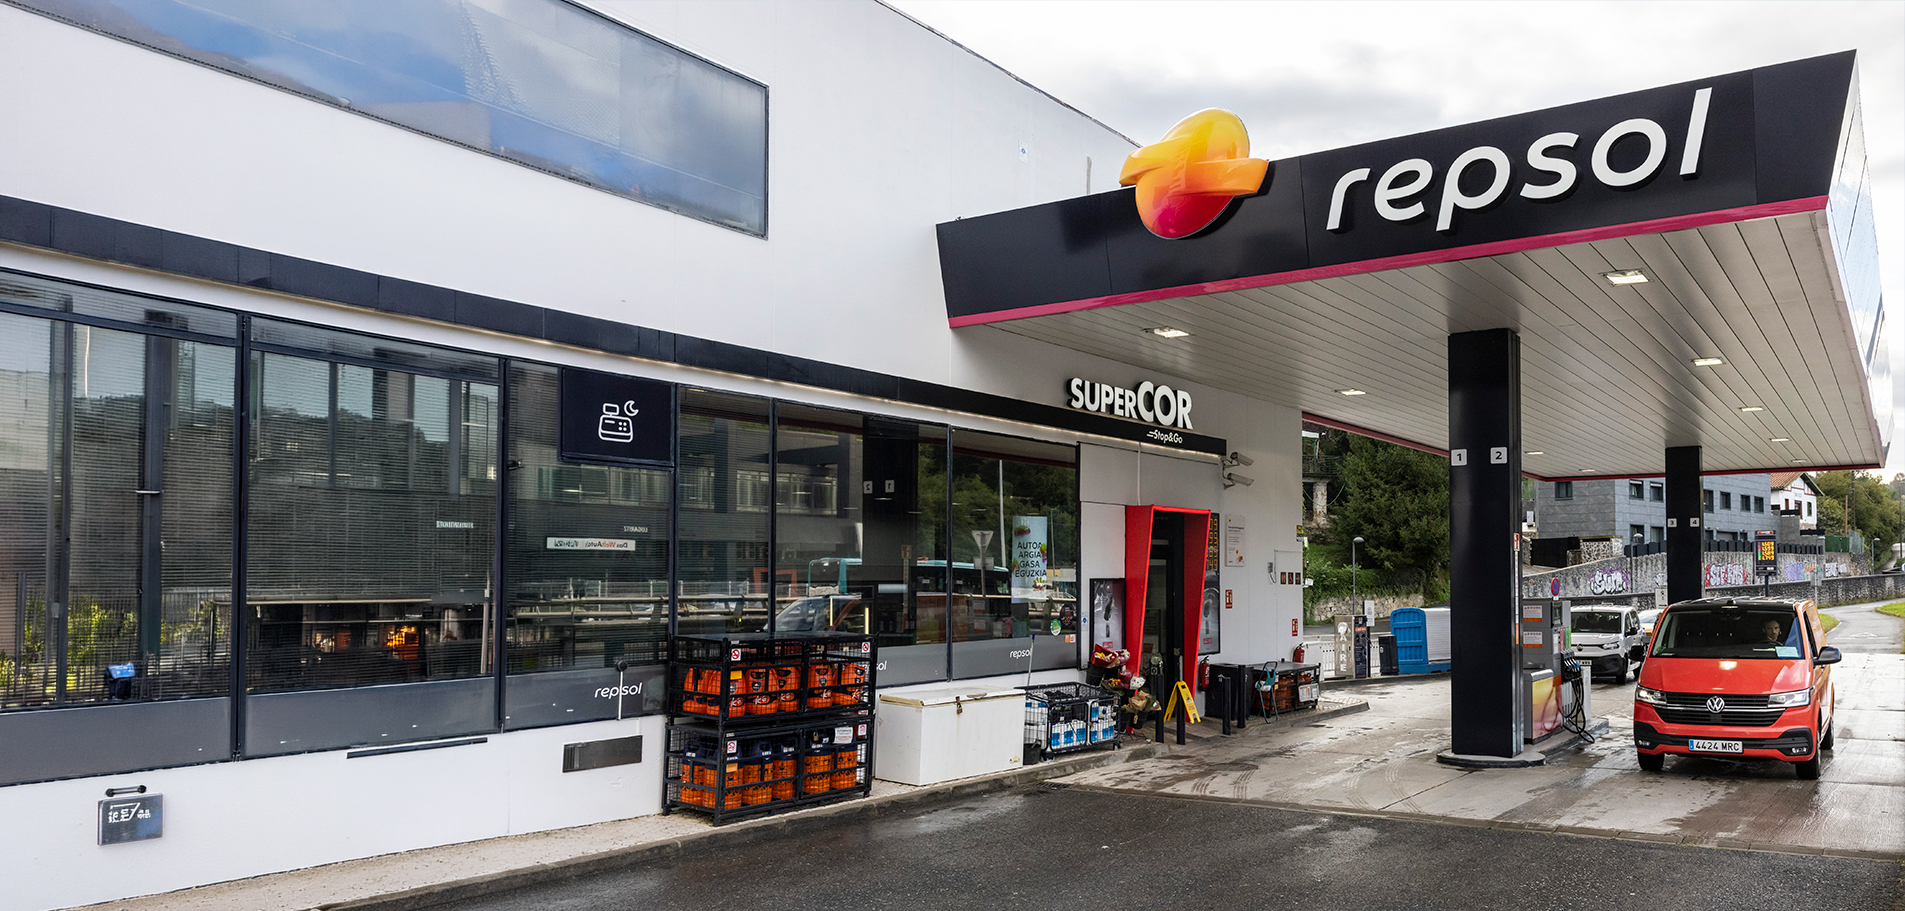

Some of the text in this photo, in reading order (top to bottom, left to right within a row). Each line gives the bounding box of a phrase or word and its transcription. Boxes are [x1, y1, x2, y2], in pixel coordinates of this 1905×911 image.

[1326, 87, 1713, 232] repsol
[1070, 377, 1193, 430] SUPERCOR
[1153, 429, 1183, 444] Stop&Go
[1456, 452, 1462, 462] 1
[1495, 450, 1503, 460] 2
[1018, 550, 1042, 559] ARGIA
[1020, 560, 1041, 568] GASA
[1015, 569, 1047, 578] EGUZKIA
[1339, 634, 1348, 672] AIRE
[594, 682, 643, 700] repsol
[1695, 741, 1740, 751] 4424 MRC
